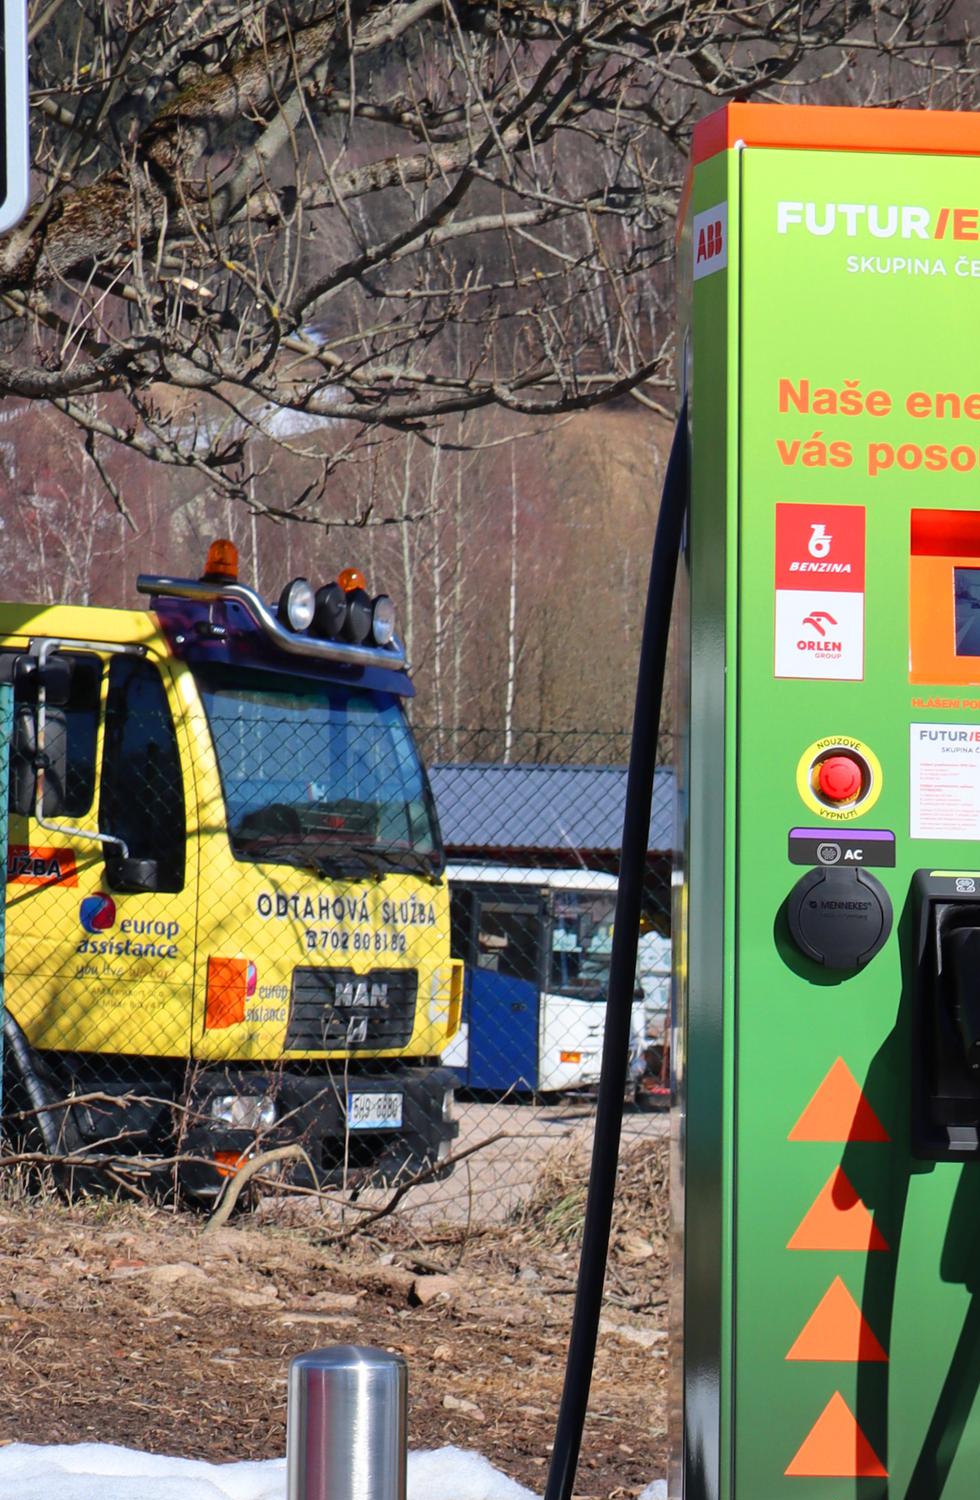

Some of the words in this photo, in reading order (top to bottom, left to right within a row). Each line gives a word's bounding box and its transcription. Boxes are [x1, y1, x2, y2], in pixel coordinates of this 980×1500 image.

[696, 220, 723, 264] ABB
[846, 255, 948, 277] SKUPINA
[778, 378, 892, 417] Naše
[775, 431, 854, 469] vás
[788, 561, 852, 573] BENZINA
[796, 640, 842, 652] ORLEN
[814, 652, 842, 660] GROUP
[941, 746, 974, 754] SKUPINA
[843, 849, 864, 861] AC
[257, 891, 370, 923] ODTAHOVÁ
[382, 895, 436, 926] SLUŽBA
[120, 918, 180, 940] europ
[76, 936, 179, 959] assistance
[334, 982, 389, 1008] MAN
